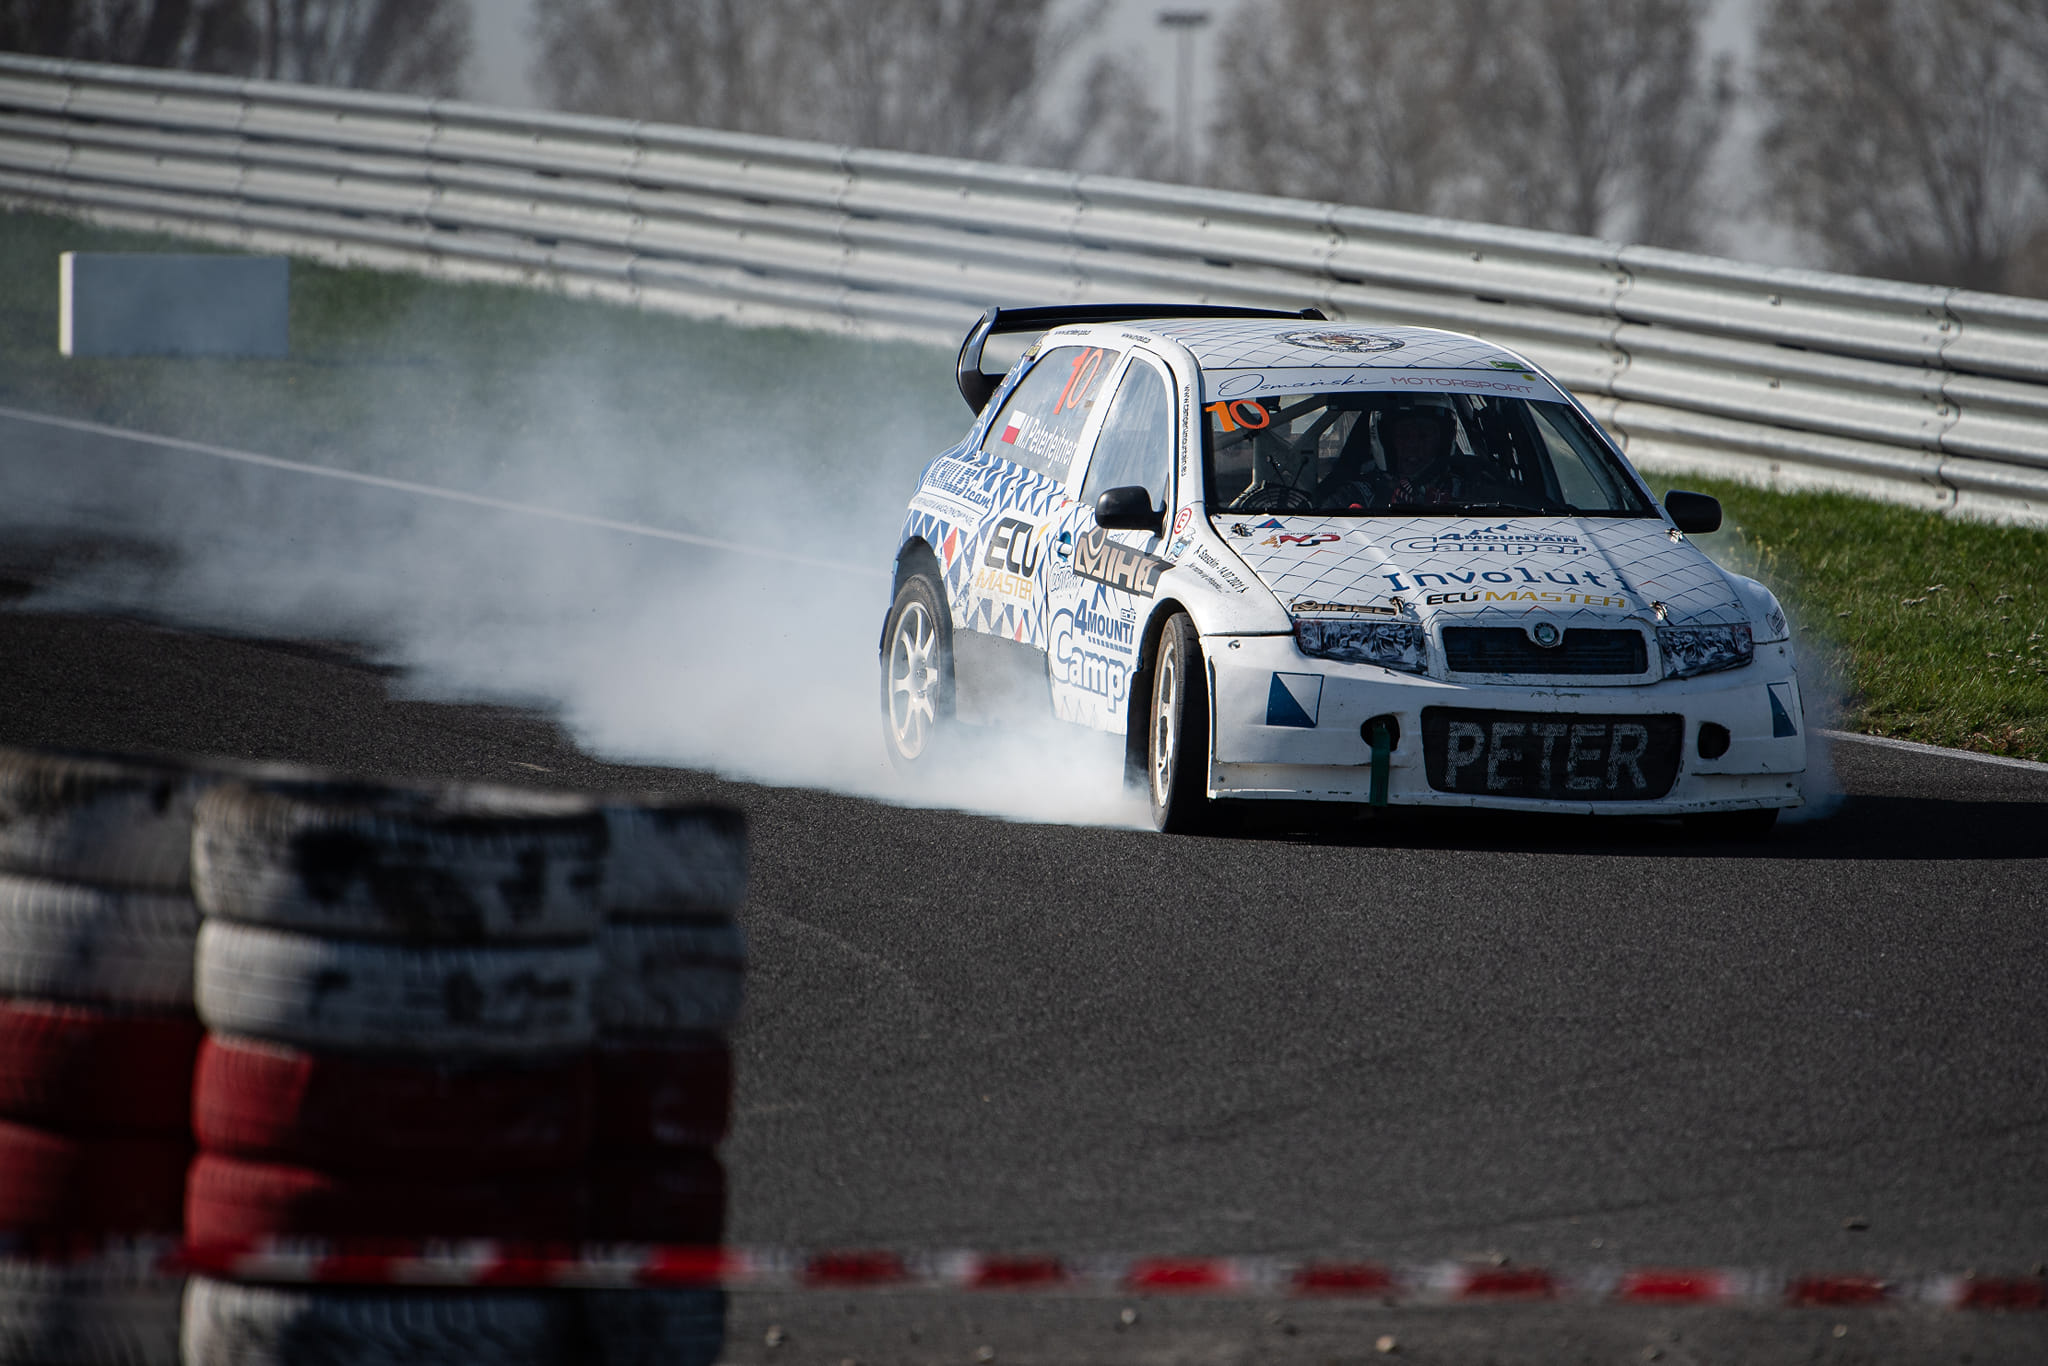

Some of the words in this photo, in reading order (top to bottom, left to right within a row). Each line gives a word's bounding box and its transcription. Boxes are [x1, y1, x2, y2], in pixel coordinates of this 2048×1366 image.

[1053, 347, 1103, 415] 10
[1390, 376, 1533, 393] MOTORSPORT
[1205, 399, 1270, 432] 10
[984, 517, 1041, 577] ECU
[1391, 537, 1587, 555] Camper
[975, 567, 1033, 601] MASTER
[1427, 592, 1479, 605] ECU
[1484, 591, 1625, 608] MASTER
[1074, 599, 1135, 645] 4MOUNT
[1051, 608, 1132, 714] Camp
[1445, 721, 1648, 790] PETER
